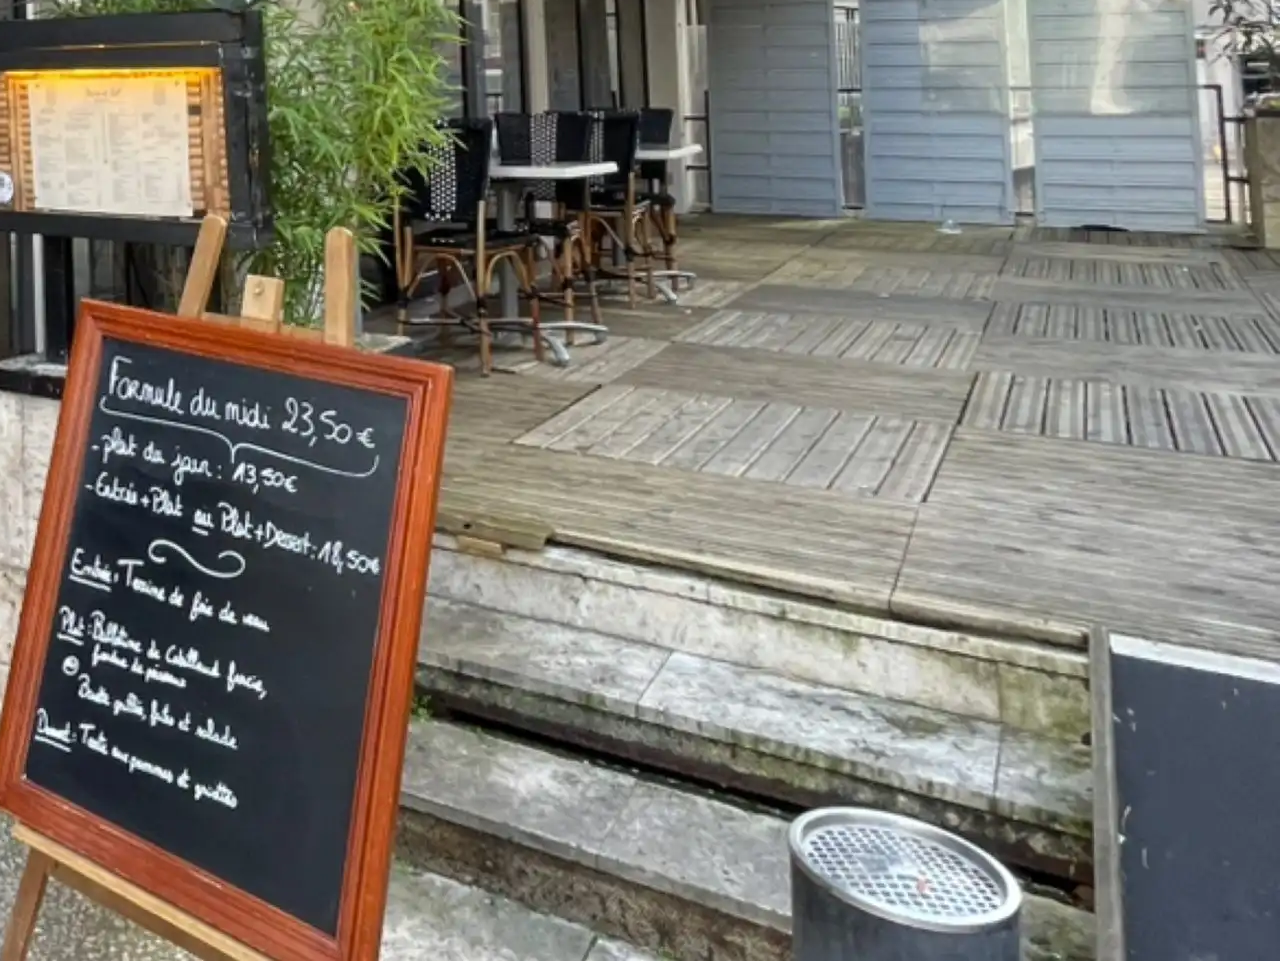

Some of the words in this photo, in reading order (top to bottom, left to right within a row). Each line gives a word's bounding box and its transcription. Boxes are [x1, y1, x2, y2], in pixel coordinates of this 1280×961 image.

[107, 355, 185, 415] Formule
[189, 385, 221, 420] du
[224, 396, 271, 430] midi
[142, 440, 165, 464] du
[231, 460, 299, 495] 13,50€
[167, 584, 184, 608] de
[217, 600, 238, 625] de
